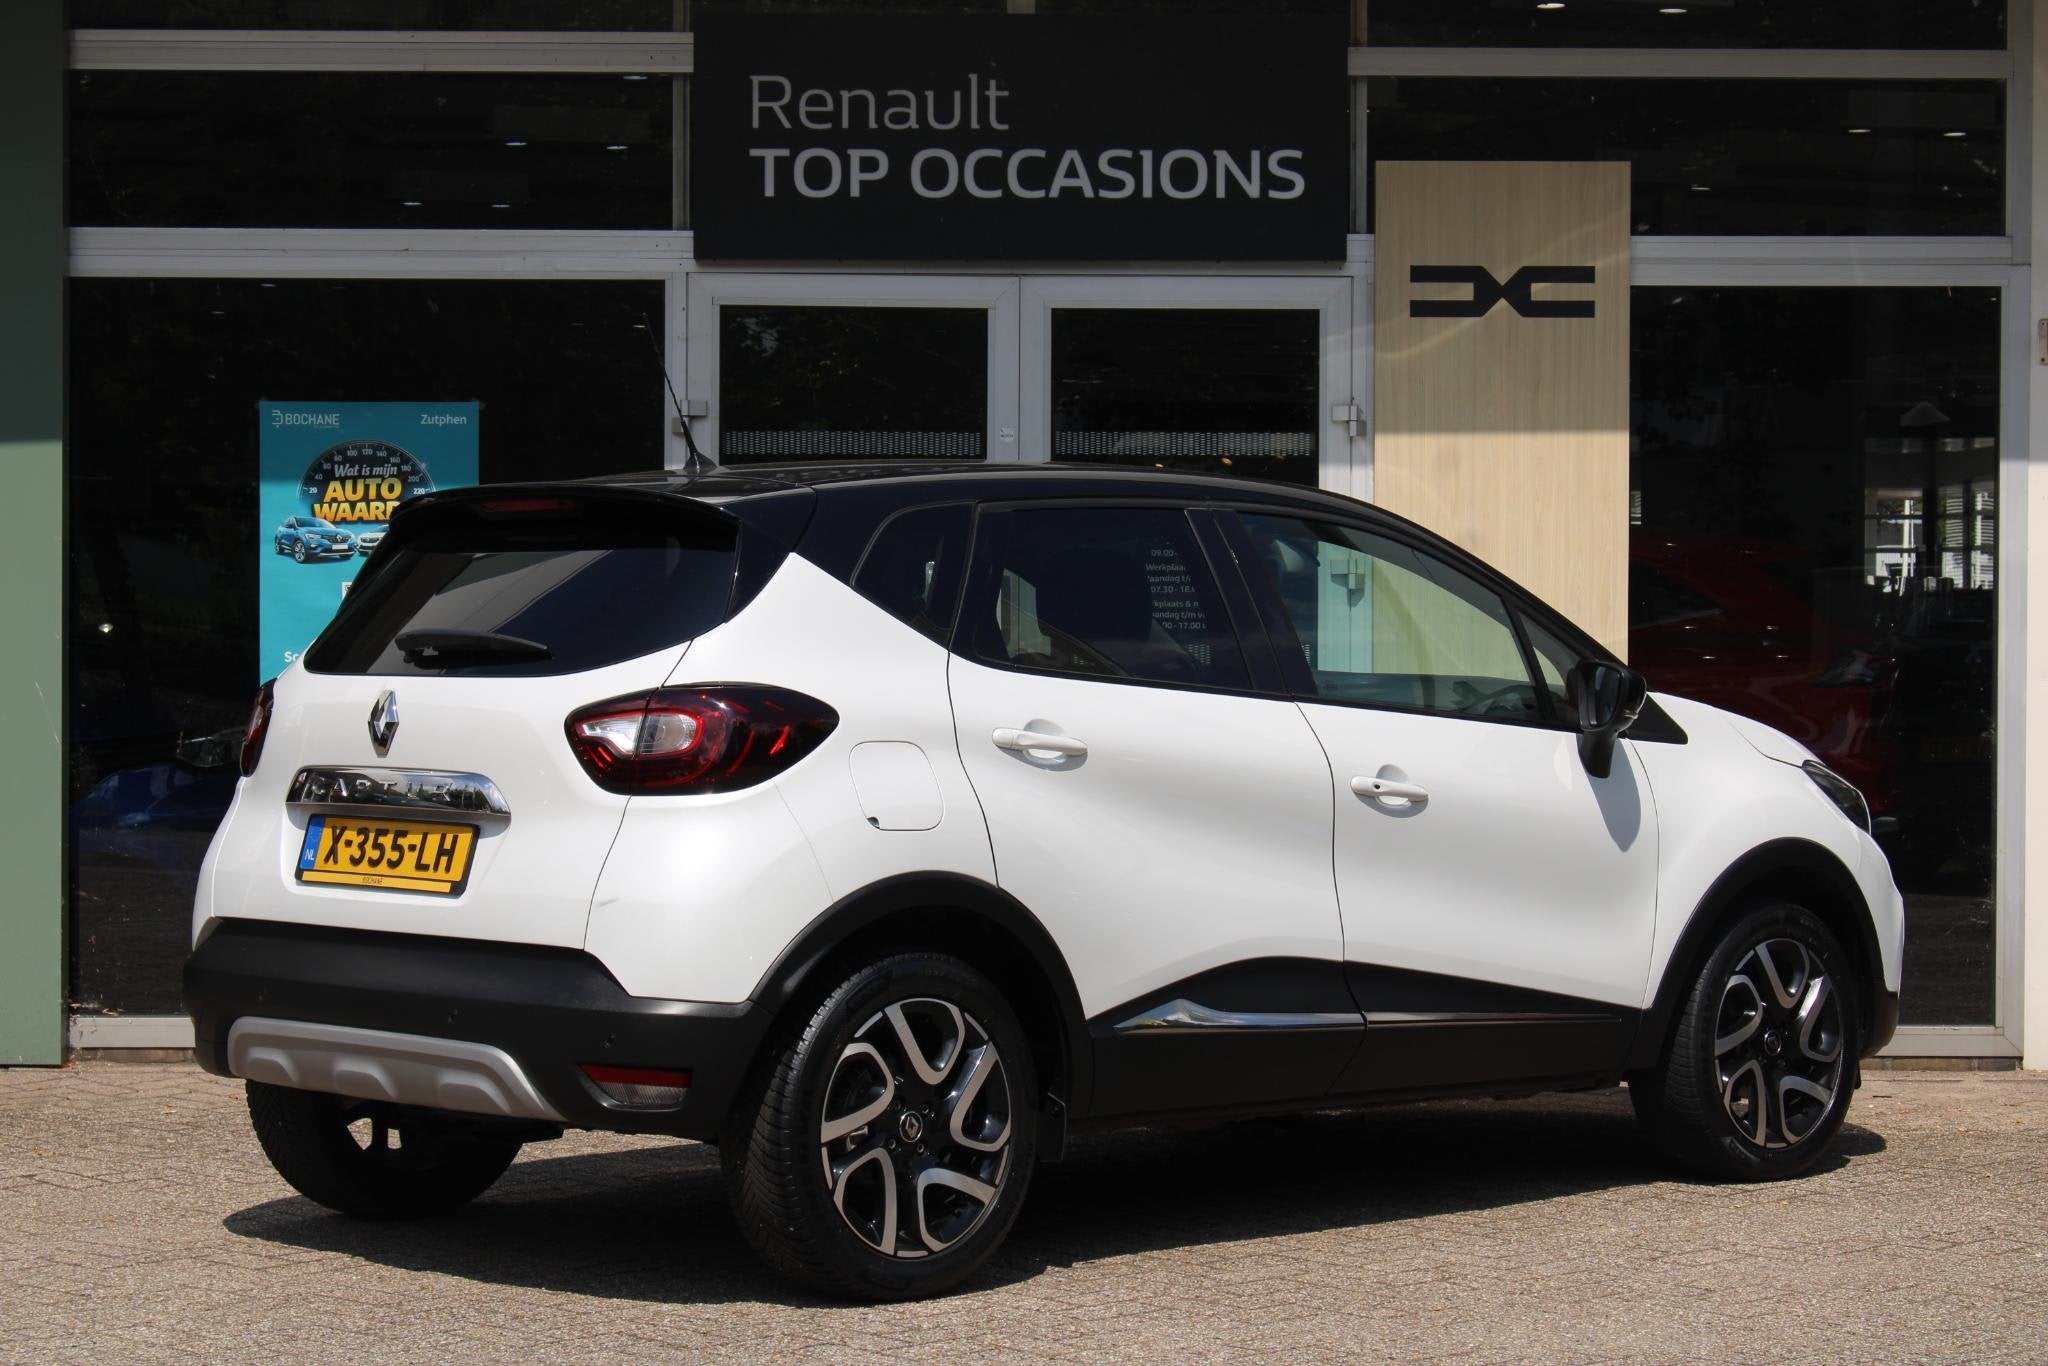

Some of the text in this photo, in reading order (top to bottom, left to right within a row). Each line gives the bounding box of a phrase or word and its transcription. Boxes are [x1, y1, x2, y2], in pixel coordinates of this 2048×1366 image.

[750, 73, 1010, 131] Renault
[749, 148, 1306, 200] TOP OCCASIONS
[284, 413, 340, 426] BOCHANE
[420, 414, 467, 426] Zutphen
[334, 464, 398, 478] Wat is mijn
[323, 477, 402, 503] AUTO
[413, 487, 425, 495] 220
[1145, 563, 1186, 572] Werkplaa
[1147, 575, 1180, 583] aandag
[304, 849, 315, 861] NL
[323, 825, 459, 874] X-355-LH
